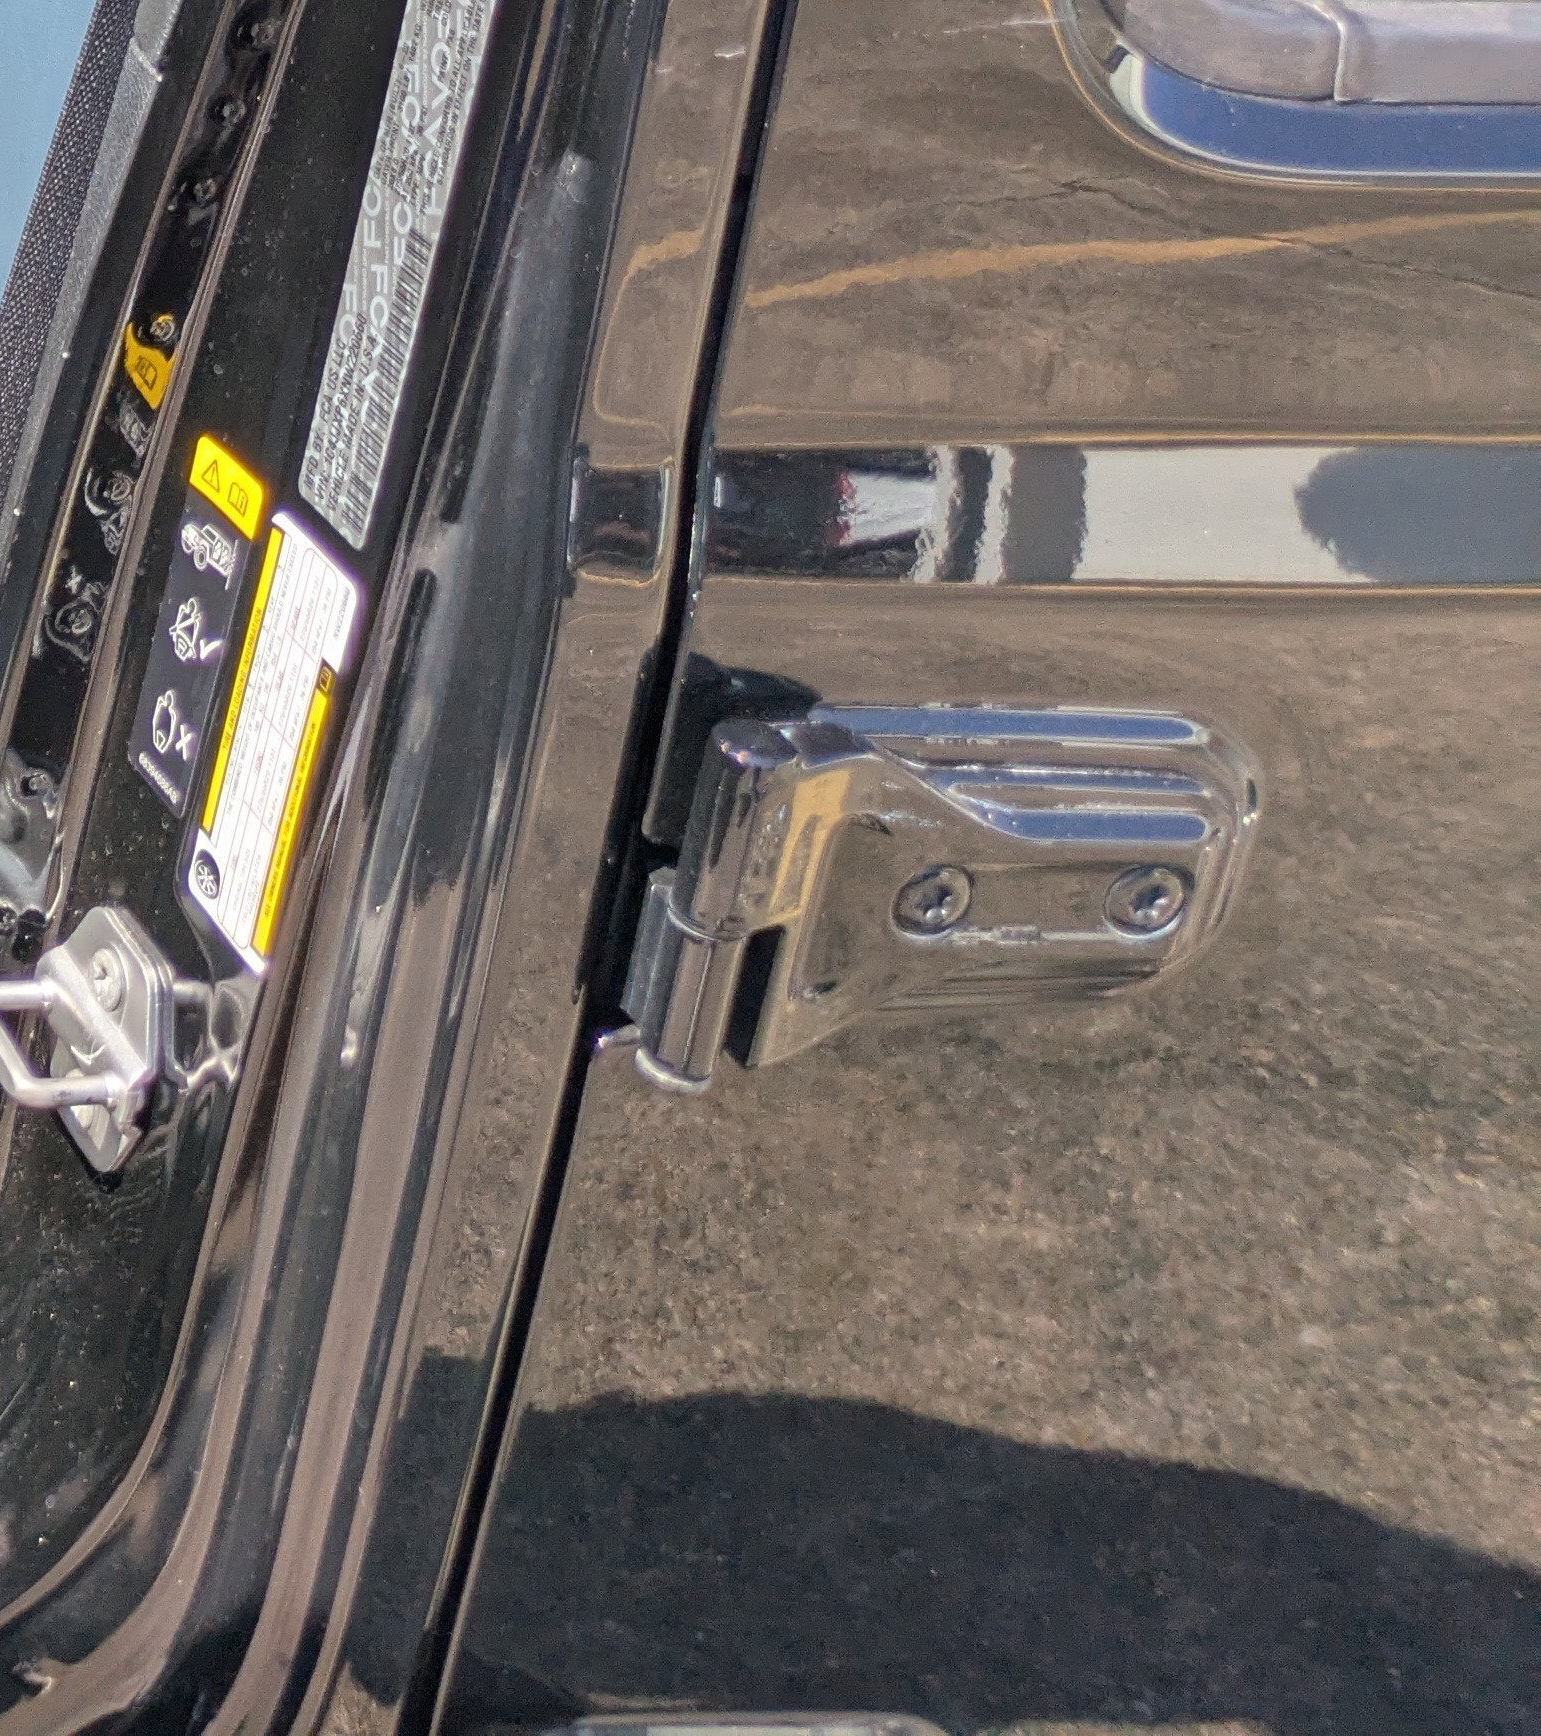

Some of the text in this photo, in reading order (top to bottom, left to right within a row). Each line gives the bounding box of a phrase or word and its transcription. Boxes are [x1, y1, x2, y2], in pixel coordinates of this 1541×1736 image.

[325, 366, 339, 392] US
[318, 391, 333, 424] FCA
[326, 448, 349, 513] VEHICLE
[340, 401, 360, 451] MADE
[227, 706, 238, 731] AND
